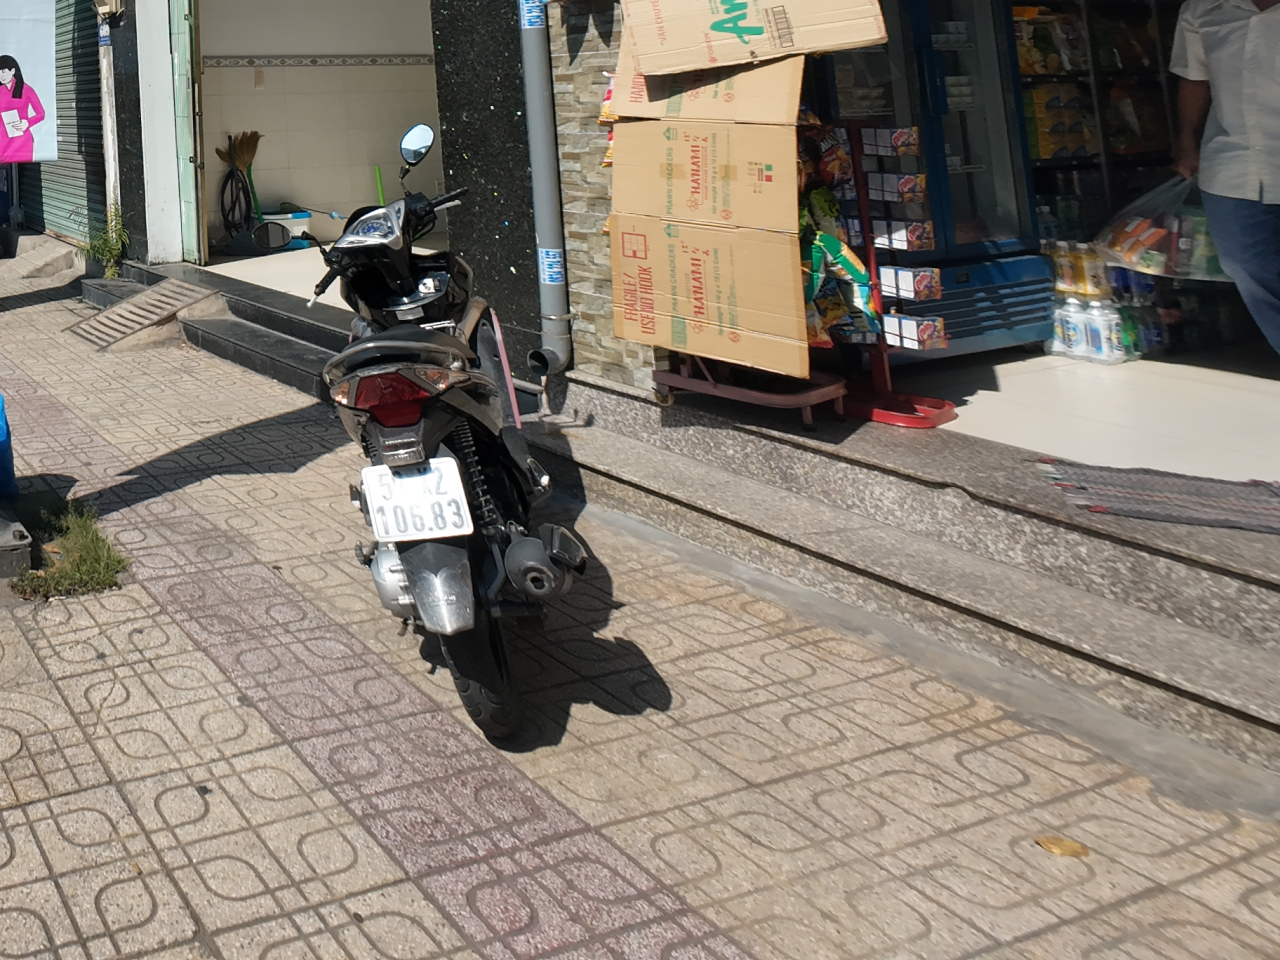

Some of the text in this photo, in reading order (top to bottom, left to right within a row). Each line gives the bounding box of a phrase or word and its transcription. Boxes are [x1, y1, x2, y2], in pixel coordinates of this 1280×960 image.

[690, 145, 701, 196] HANAMI
[638, 265, 656, 335] USE NO HOOK
[690, 257, 705, 317] HANAMI
[375, 498, 465, 536] 106.83
